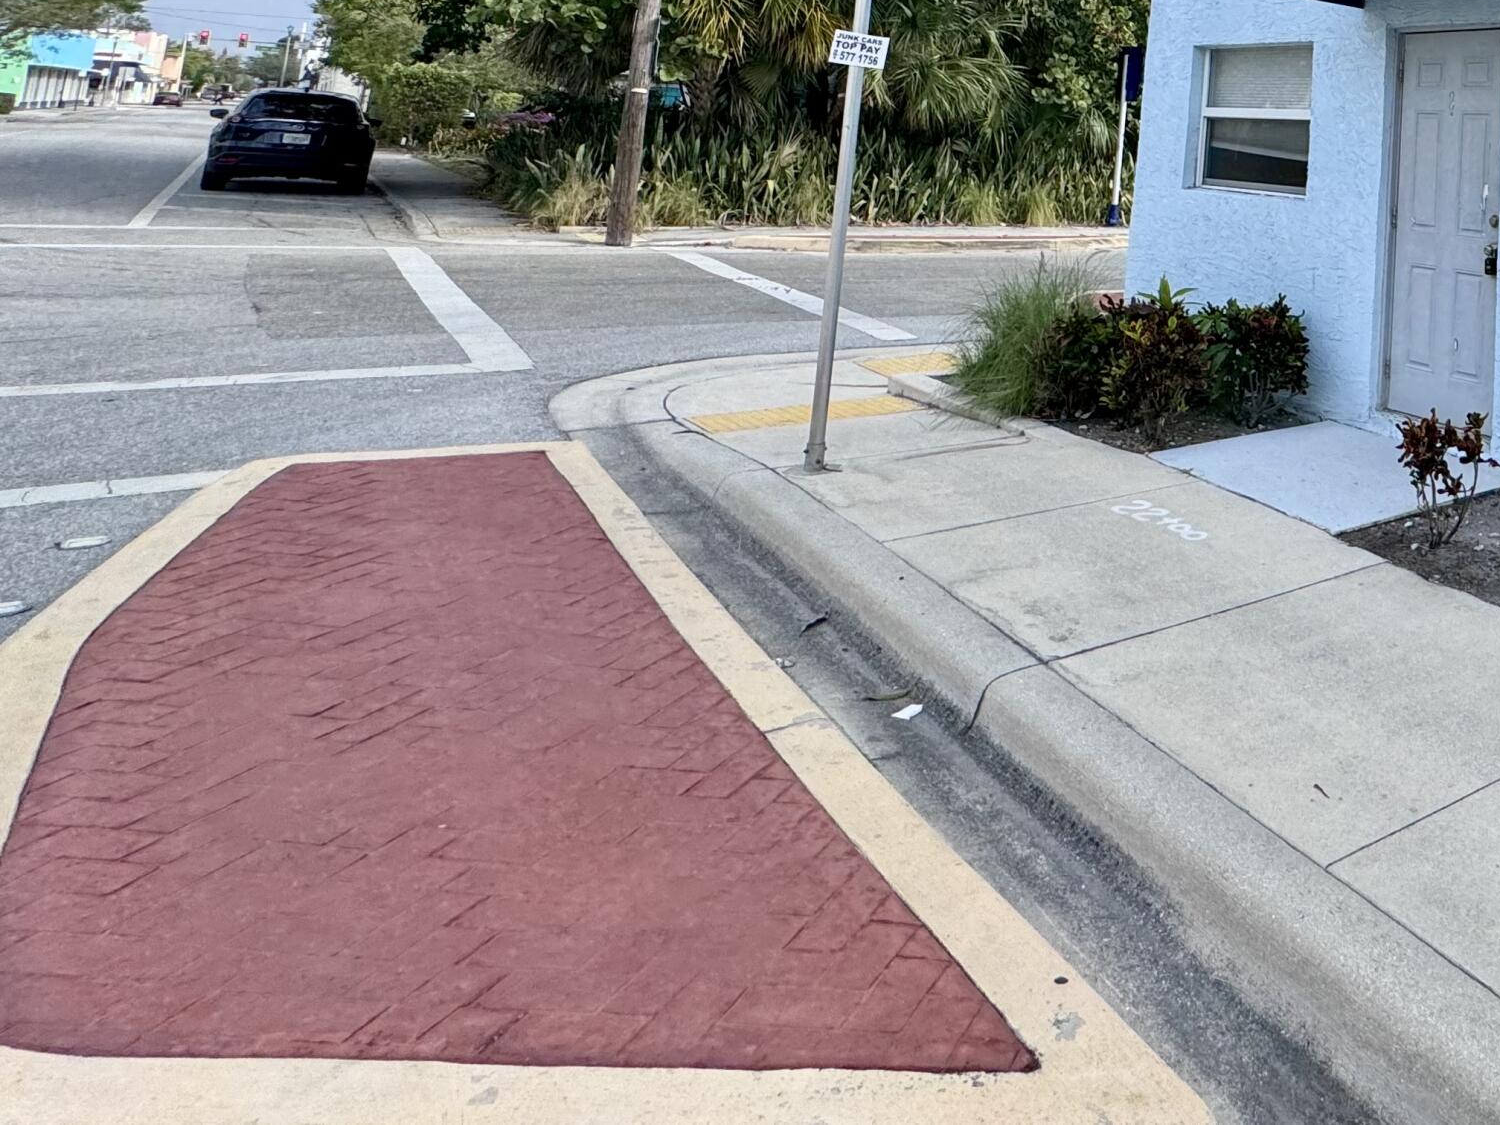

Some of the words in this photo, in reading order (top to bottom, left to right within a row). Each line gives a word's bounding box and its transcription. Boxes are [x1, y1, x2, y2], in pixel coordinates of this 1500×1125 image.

[836, 33, 860, 42] JUNK
[862, 37, 883, 46] CARS
[835, 40, 858, 50] TOP
[860, 43, 881, 55] PAY
[840, 51, 856, 62] 577
[858, 54, 879, 66] 1756
